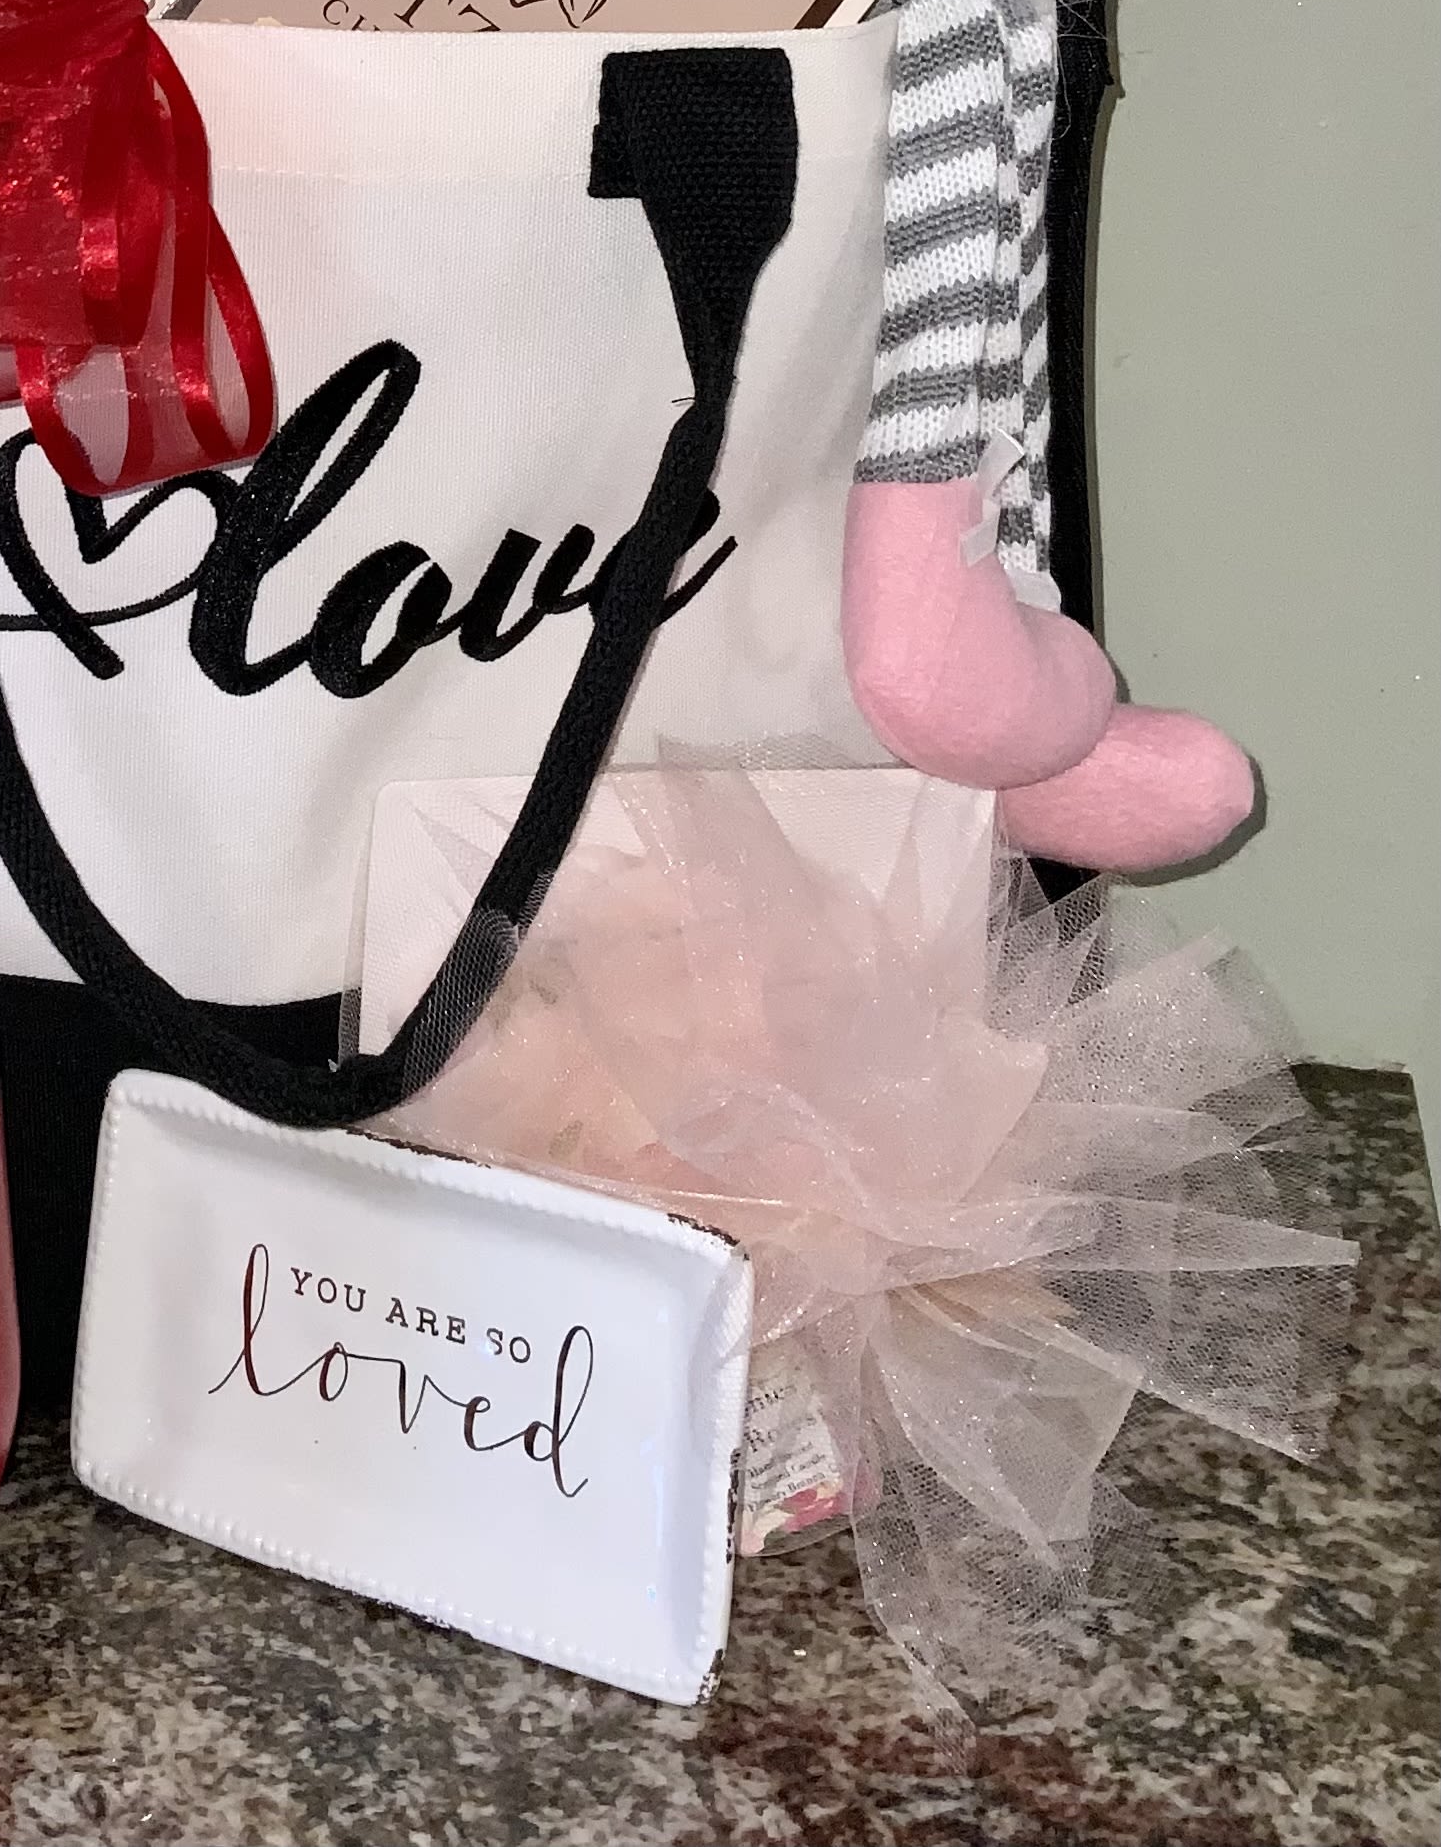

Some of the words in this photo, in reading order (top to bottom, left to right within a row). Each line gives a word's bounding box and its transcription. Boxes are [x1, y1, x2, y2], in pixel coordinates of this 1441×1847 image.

[208, 1243, 594, 1498] loved
[290, 1267, 367, 1313] YOU
[385, 1297, 466, 1345] ARE
[486, 1327, 533, 1364] SO
